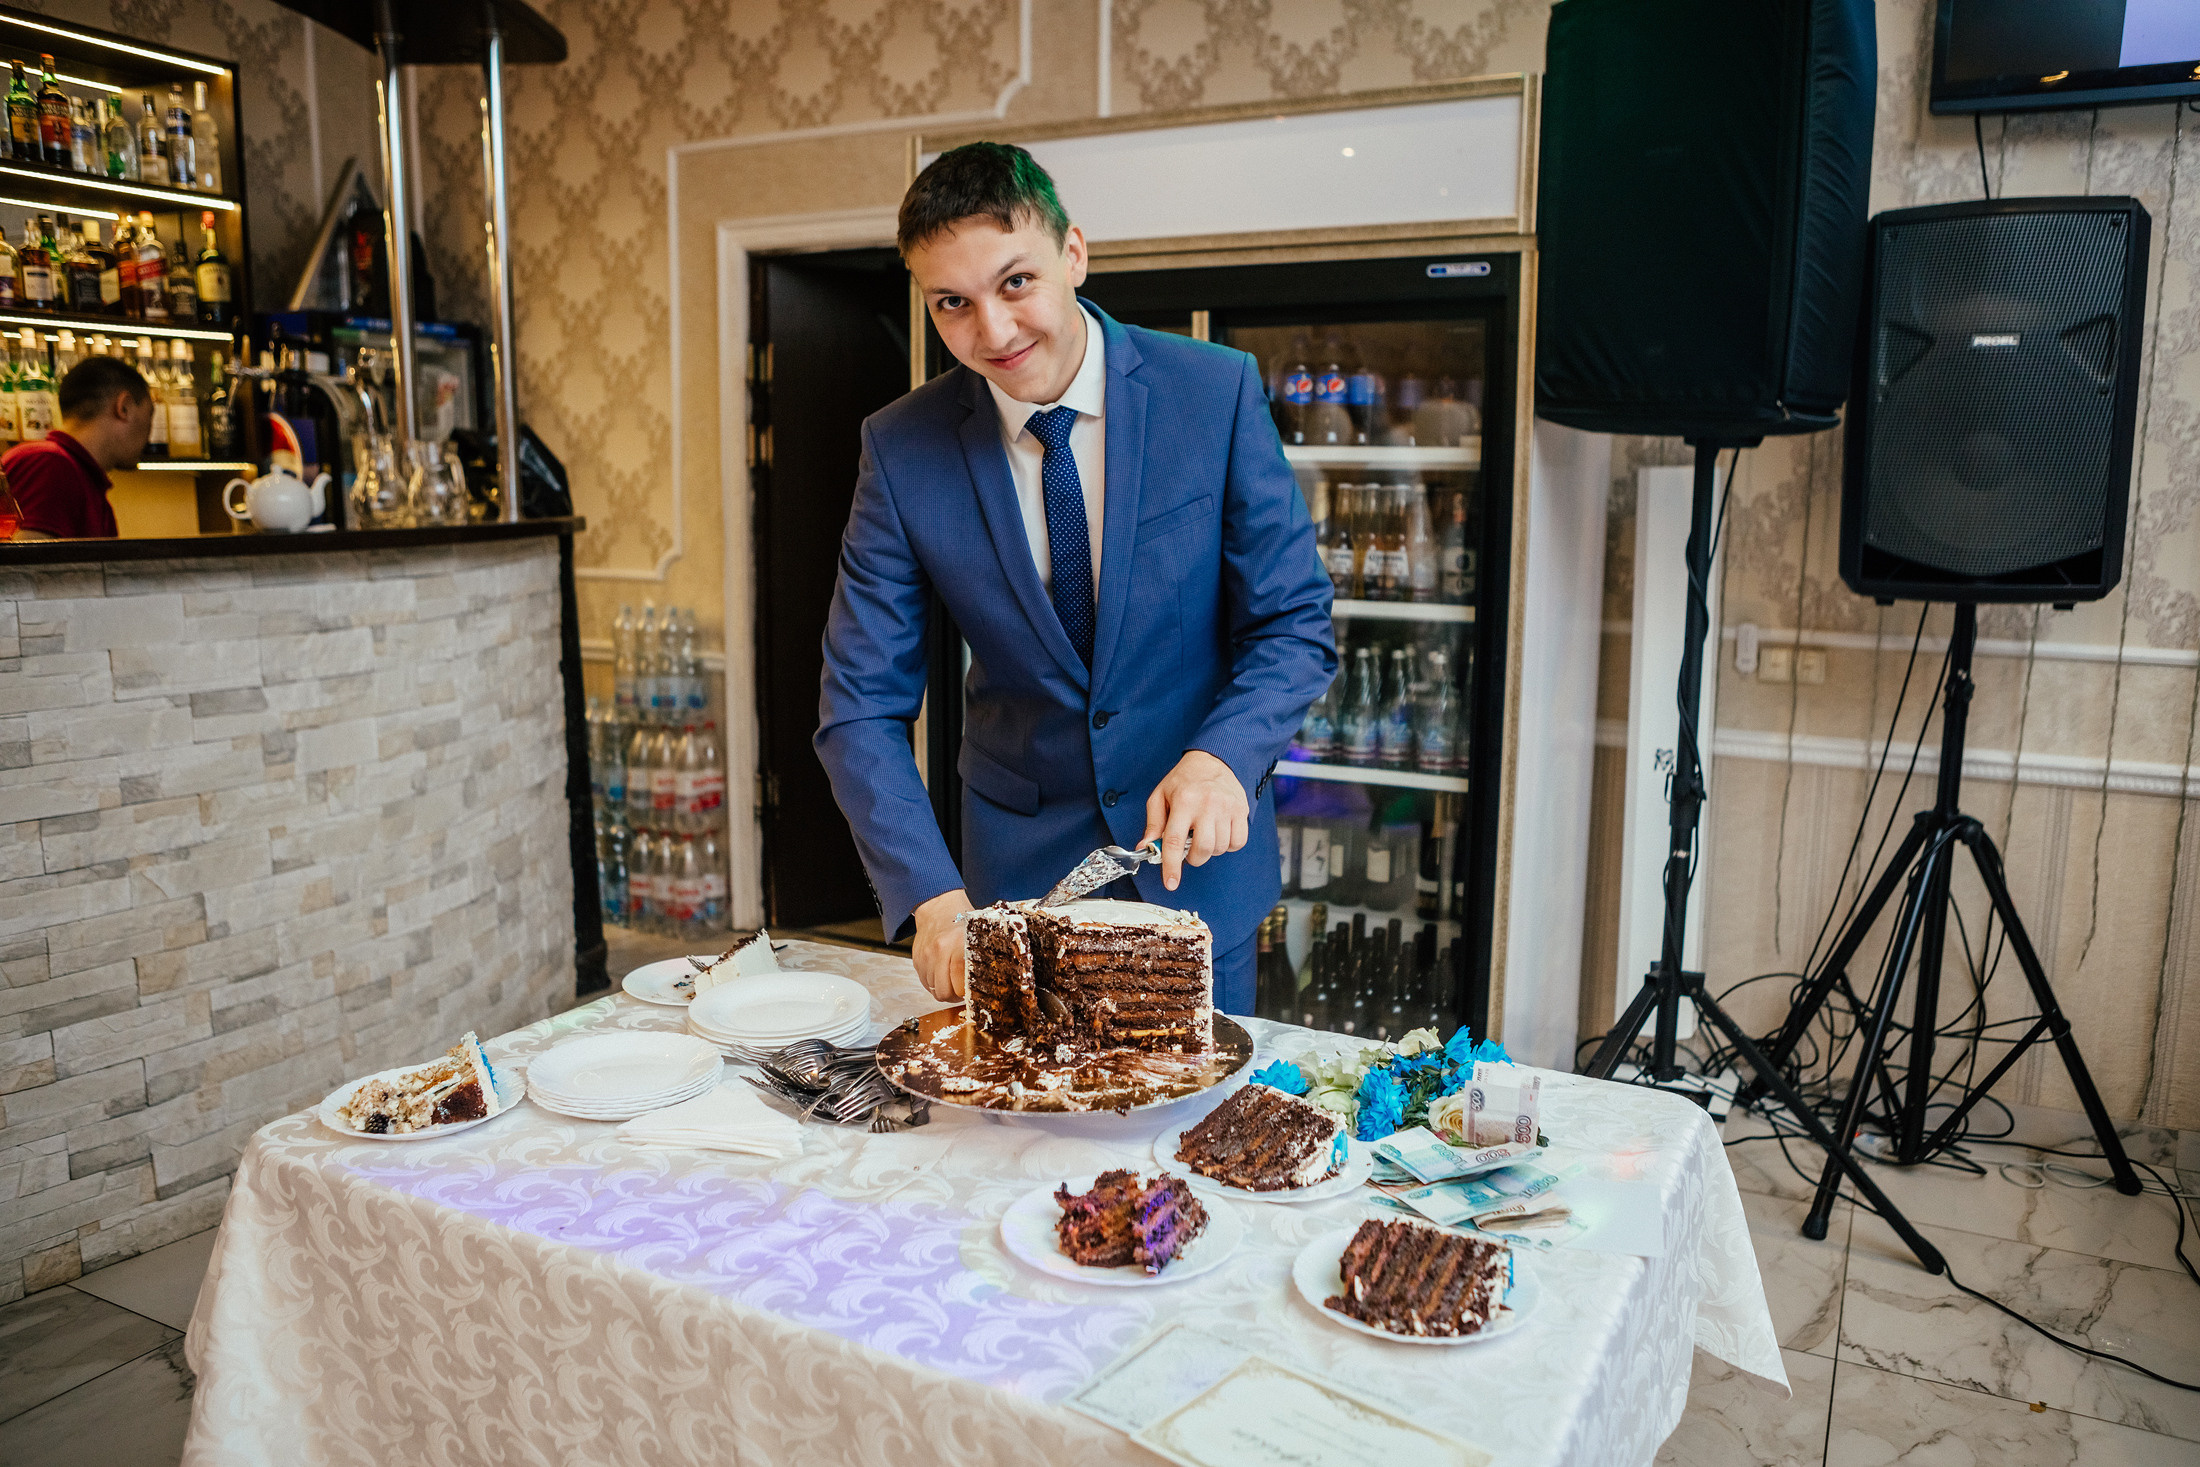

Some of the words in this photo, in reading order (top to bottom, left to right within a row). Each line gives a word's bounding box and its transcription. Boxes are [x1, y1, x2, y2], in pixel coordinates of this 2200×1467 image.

[1973, 335, 2017, 346] PROEL
[1471, 1088, 1484, 1112] 500
[1515, 1115, 1532, 1144] 500
[1519, 1175, 1558, 1199] 1000
